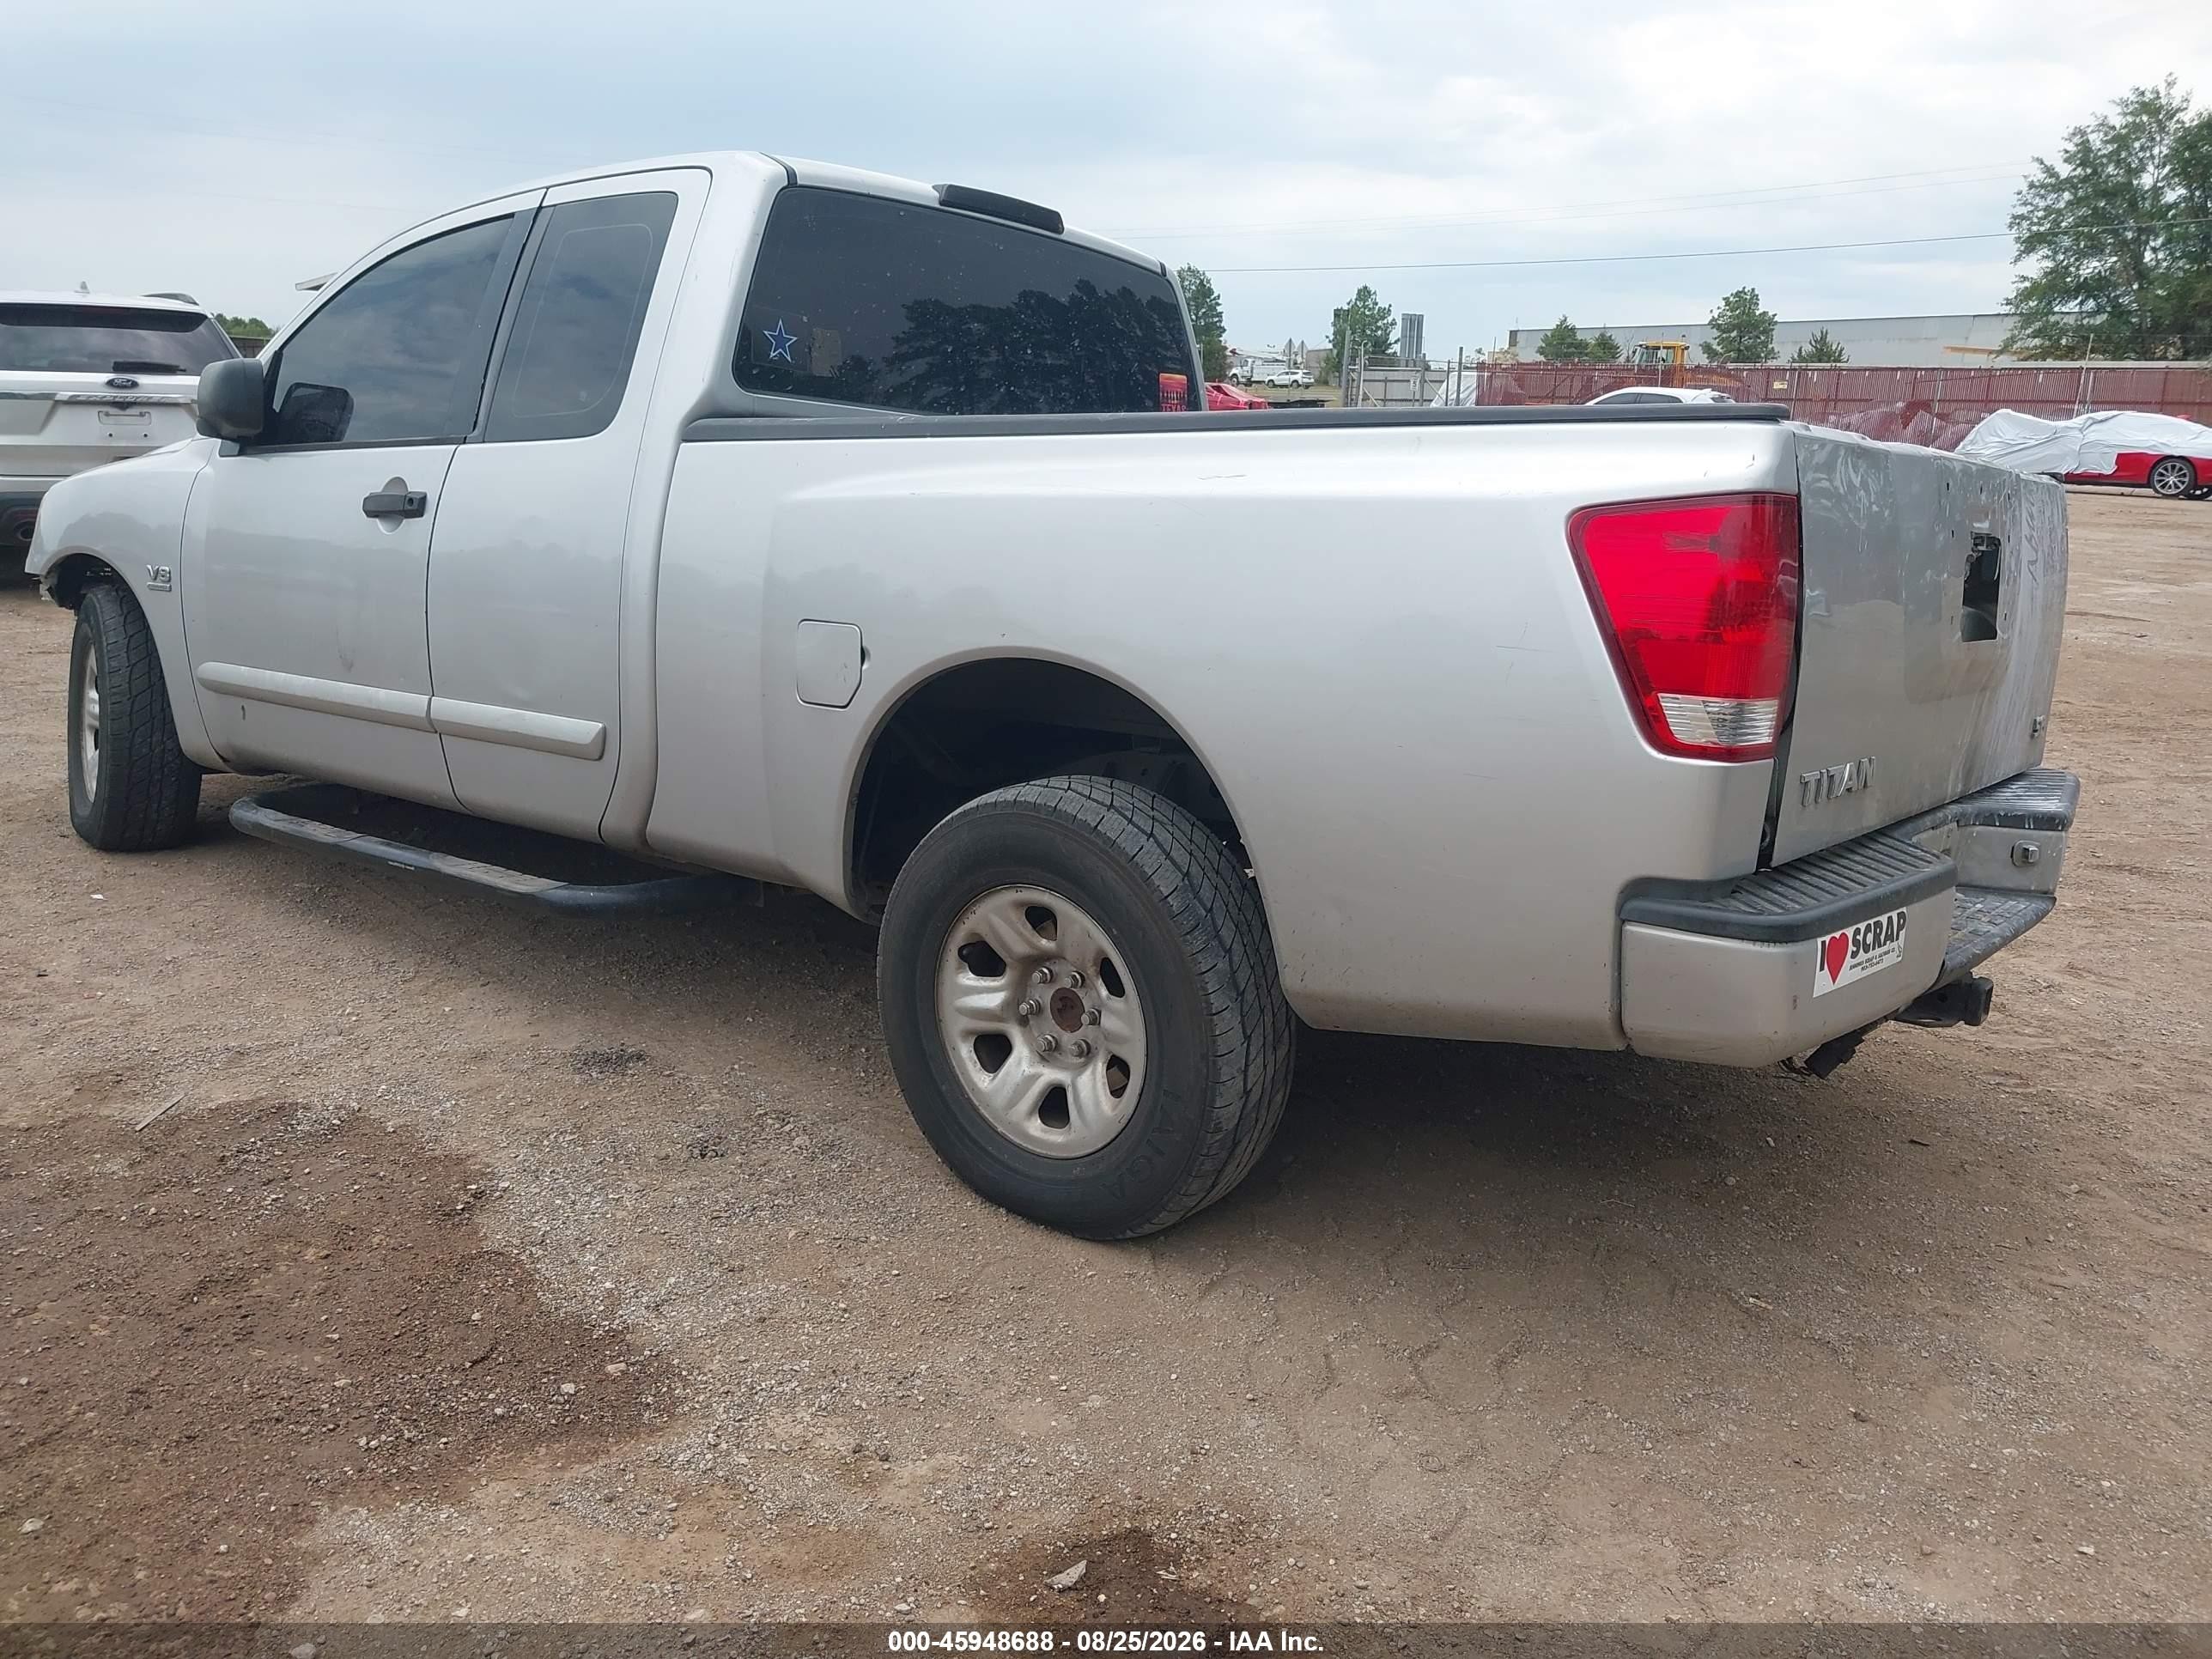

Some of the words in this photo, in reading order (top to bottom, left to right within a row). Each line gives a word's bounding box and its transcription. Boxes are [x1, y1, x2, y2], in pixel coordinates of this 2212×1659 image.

[146, 564, 172, 583] V8
[1800, 756, 1875, 807] TITAN
[1820, 940, 1826, 972] I
[1850, 911, 1906, 959] SCRAP
